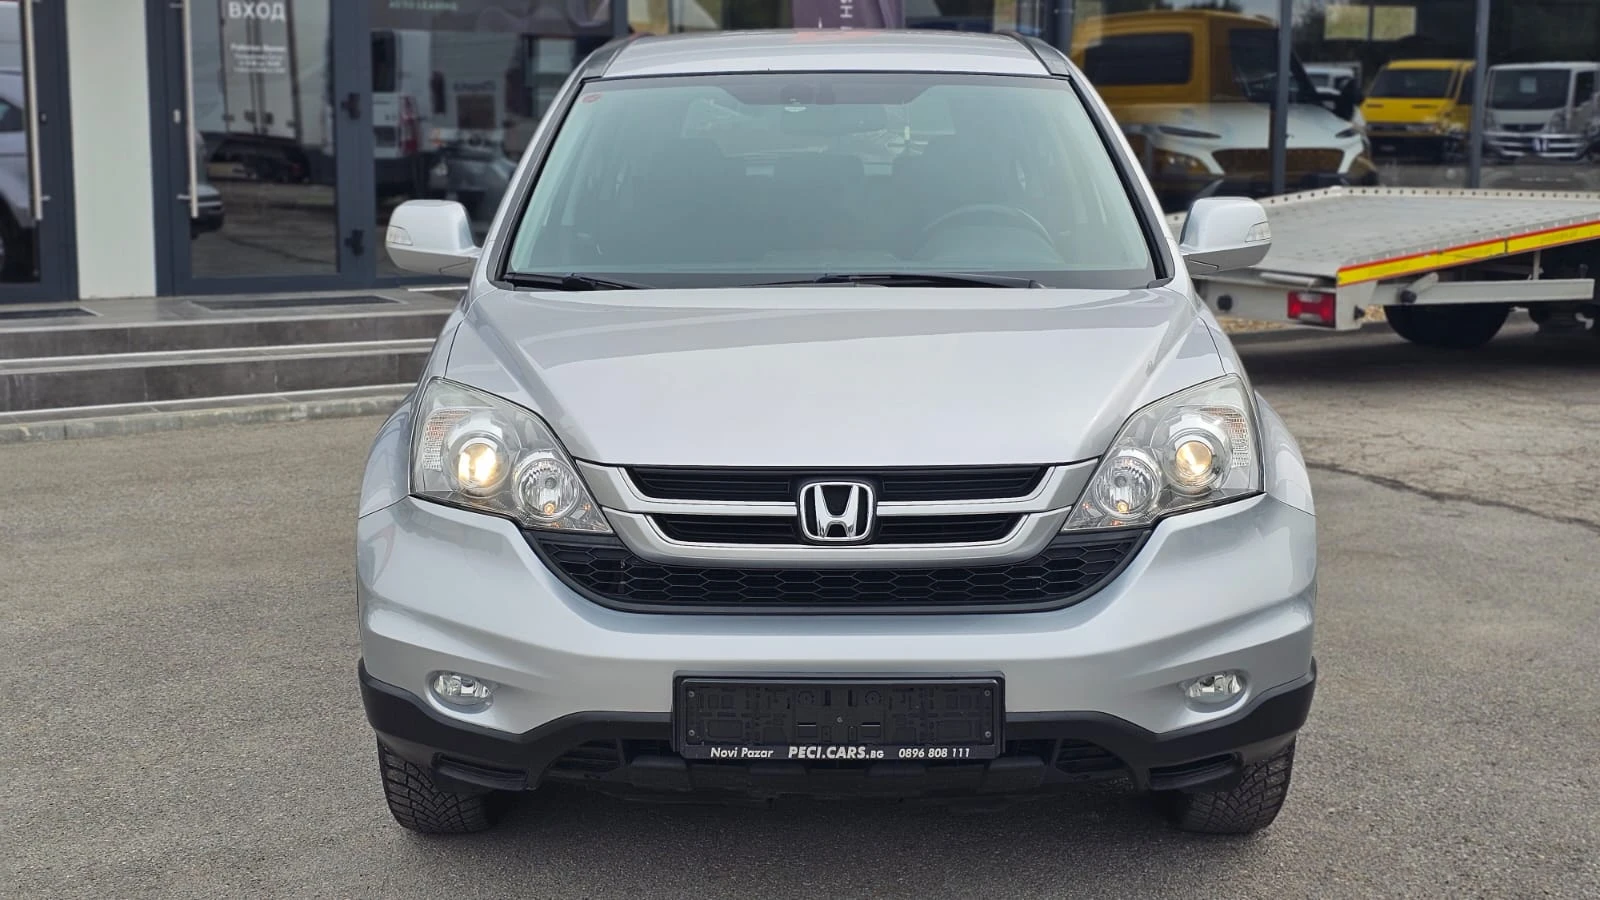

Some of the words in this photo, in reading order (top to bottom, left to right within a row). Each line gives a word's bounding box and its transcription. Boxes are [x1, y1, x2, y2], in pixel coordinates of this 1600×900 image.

[229, 1, 286, 22] ВХОД
[710, 747, 738, 758] Novi
[741, 747, 773, 758] Pazar
[898, 748, 925, 758] 0896
[927, 748, 948, 758] 808
[952, 748, 970, 758] 111
